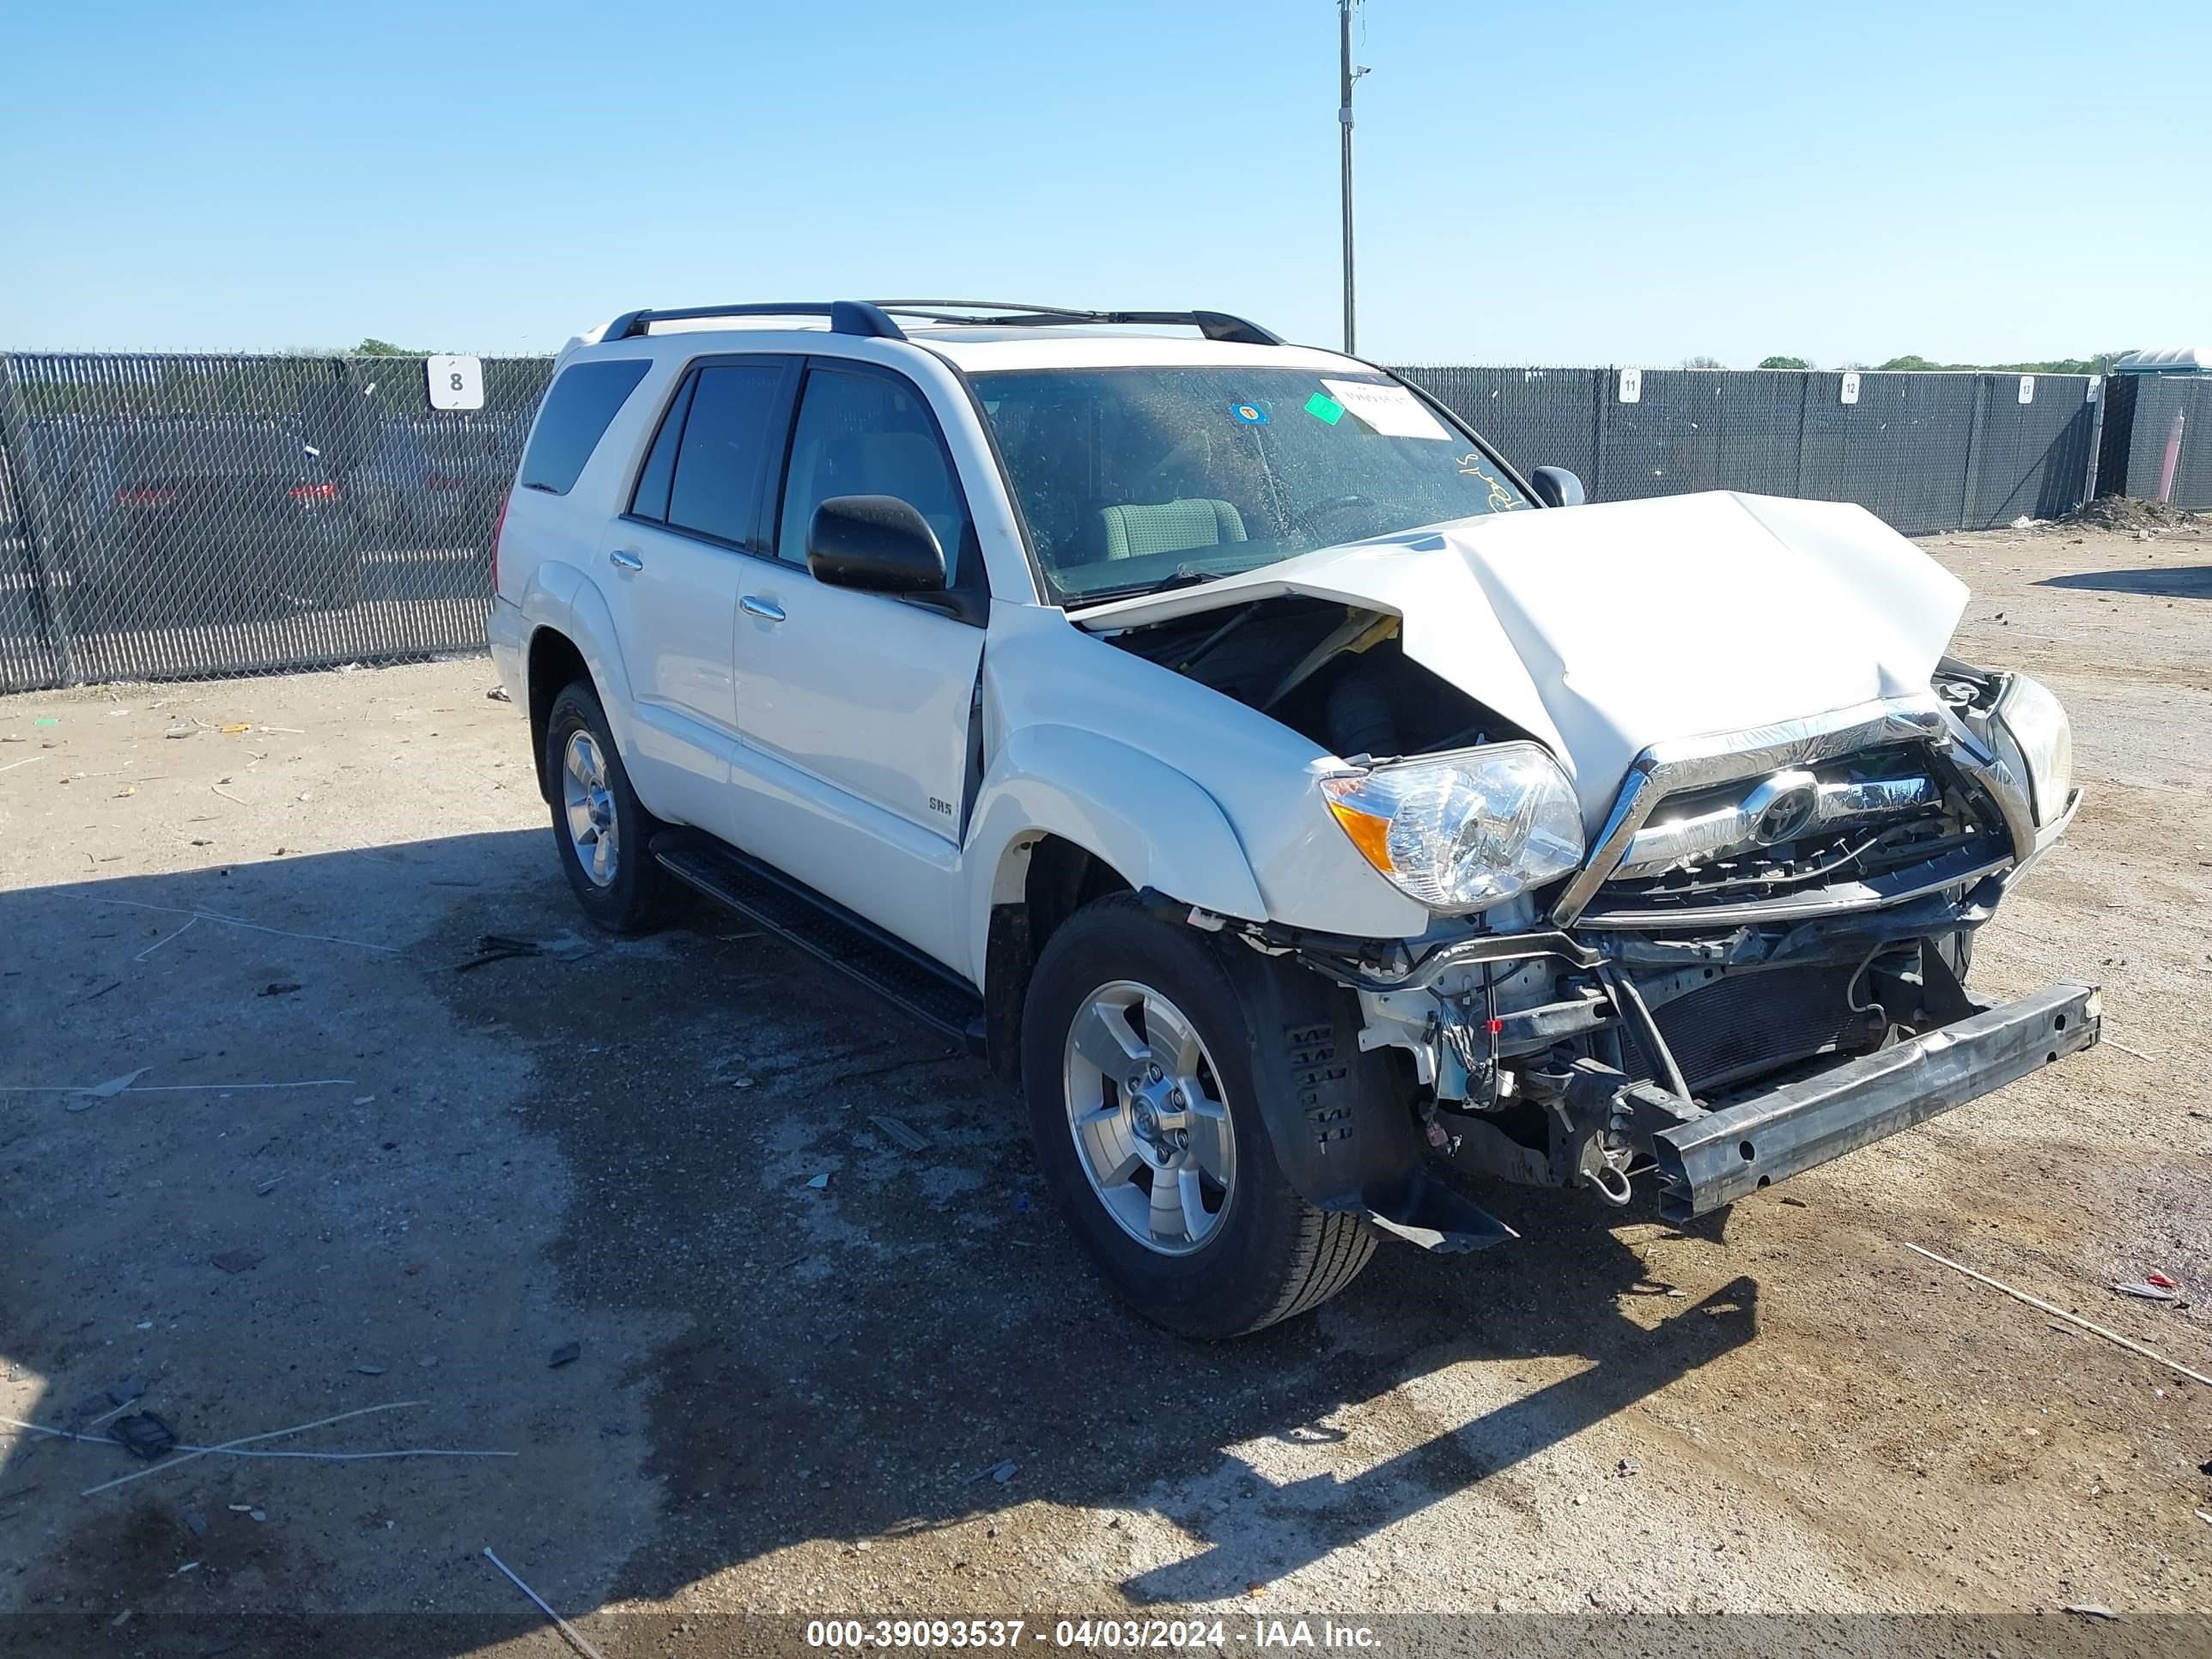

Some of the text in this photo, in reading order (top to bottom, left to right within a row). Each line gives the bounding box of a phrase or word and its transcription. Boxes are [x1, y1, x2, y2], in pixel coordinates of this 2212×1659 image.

[450, 373, 464, 392] 8
[1625, 380, 1636, 392] 11
[1846, 383, 1856, 393] 12
[2022, 385, 2031, 395] 13
[929, 796, 951, 816] SR5
